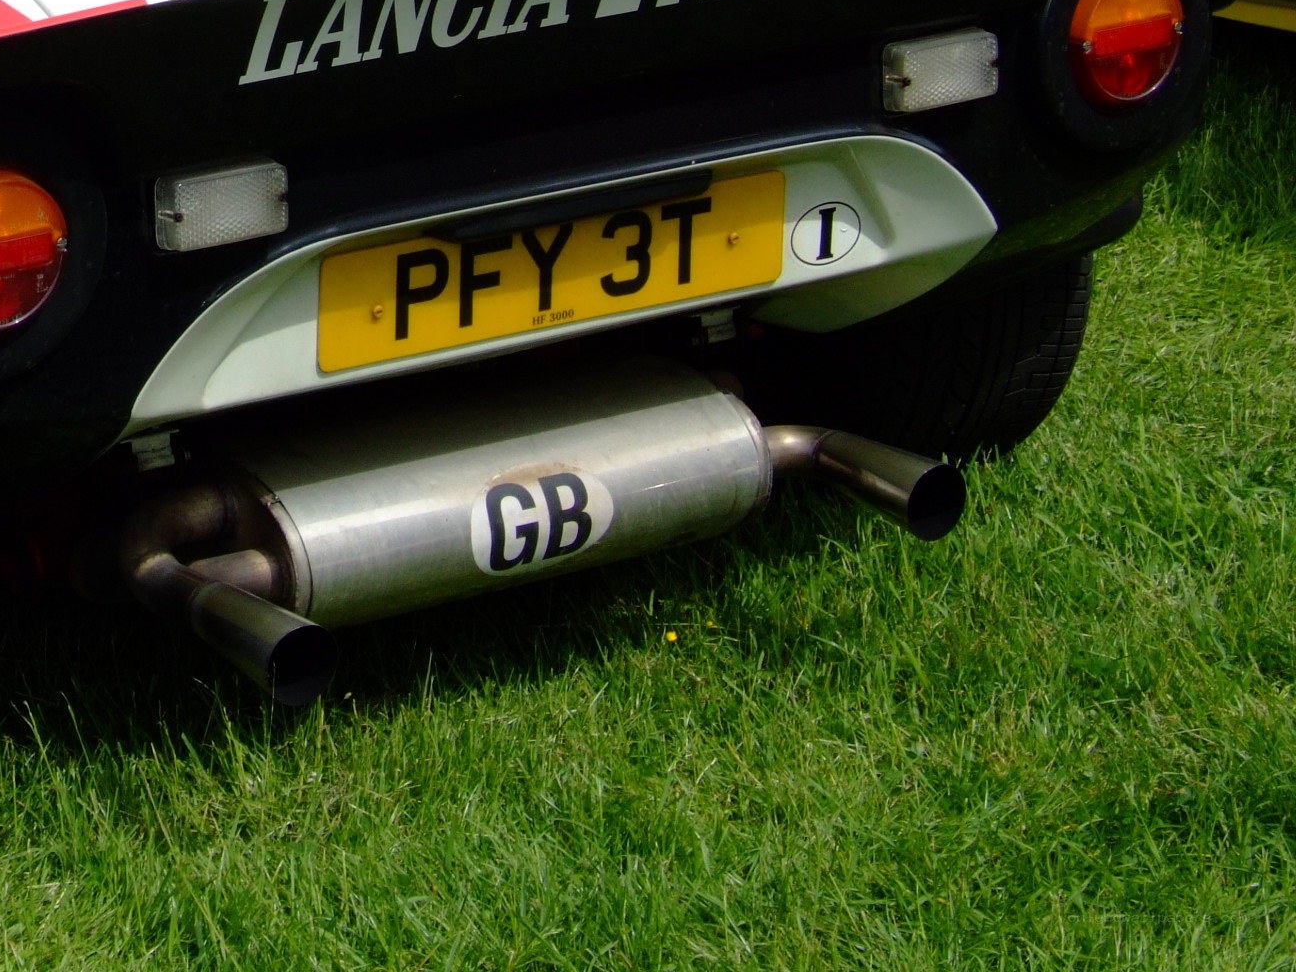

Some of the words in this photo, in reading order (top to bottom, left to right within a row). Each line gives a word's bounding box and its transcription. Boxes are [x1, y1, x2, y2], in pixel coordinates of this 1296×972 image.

[395, 223, 573, 341] PFY
[600, 198, 713, 298] 3T
[815, 206, 837, 261] I
[532, 315, 547, 326] HF
[549, 309, 575, 322] 3000
[486, 473, 592, 571] GB
